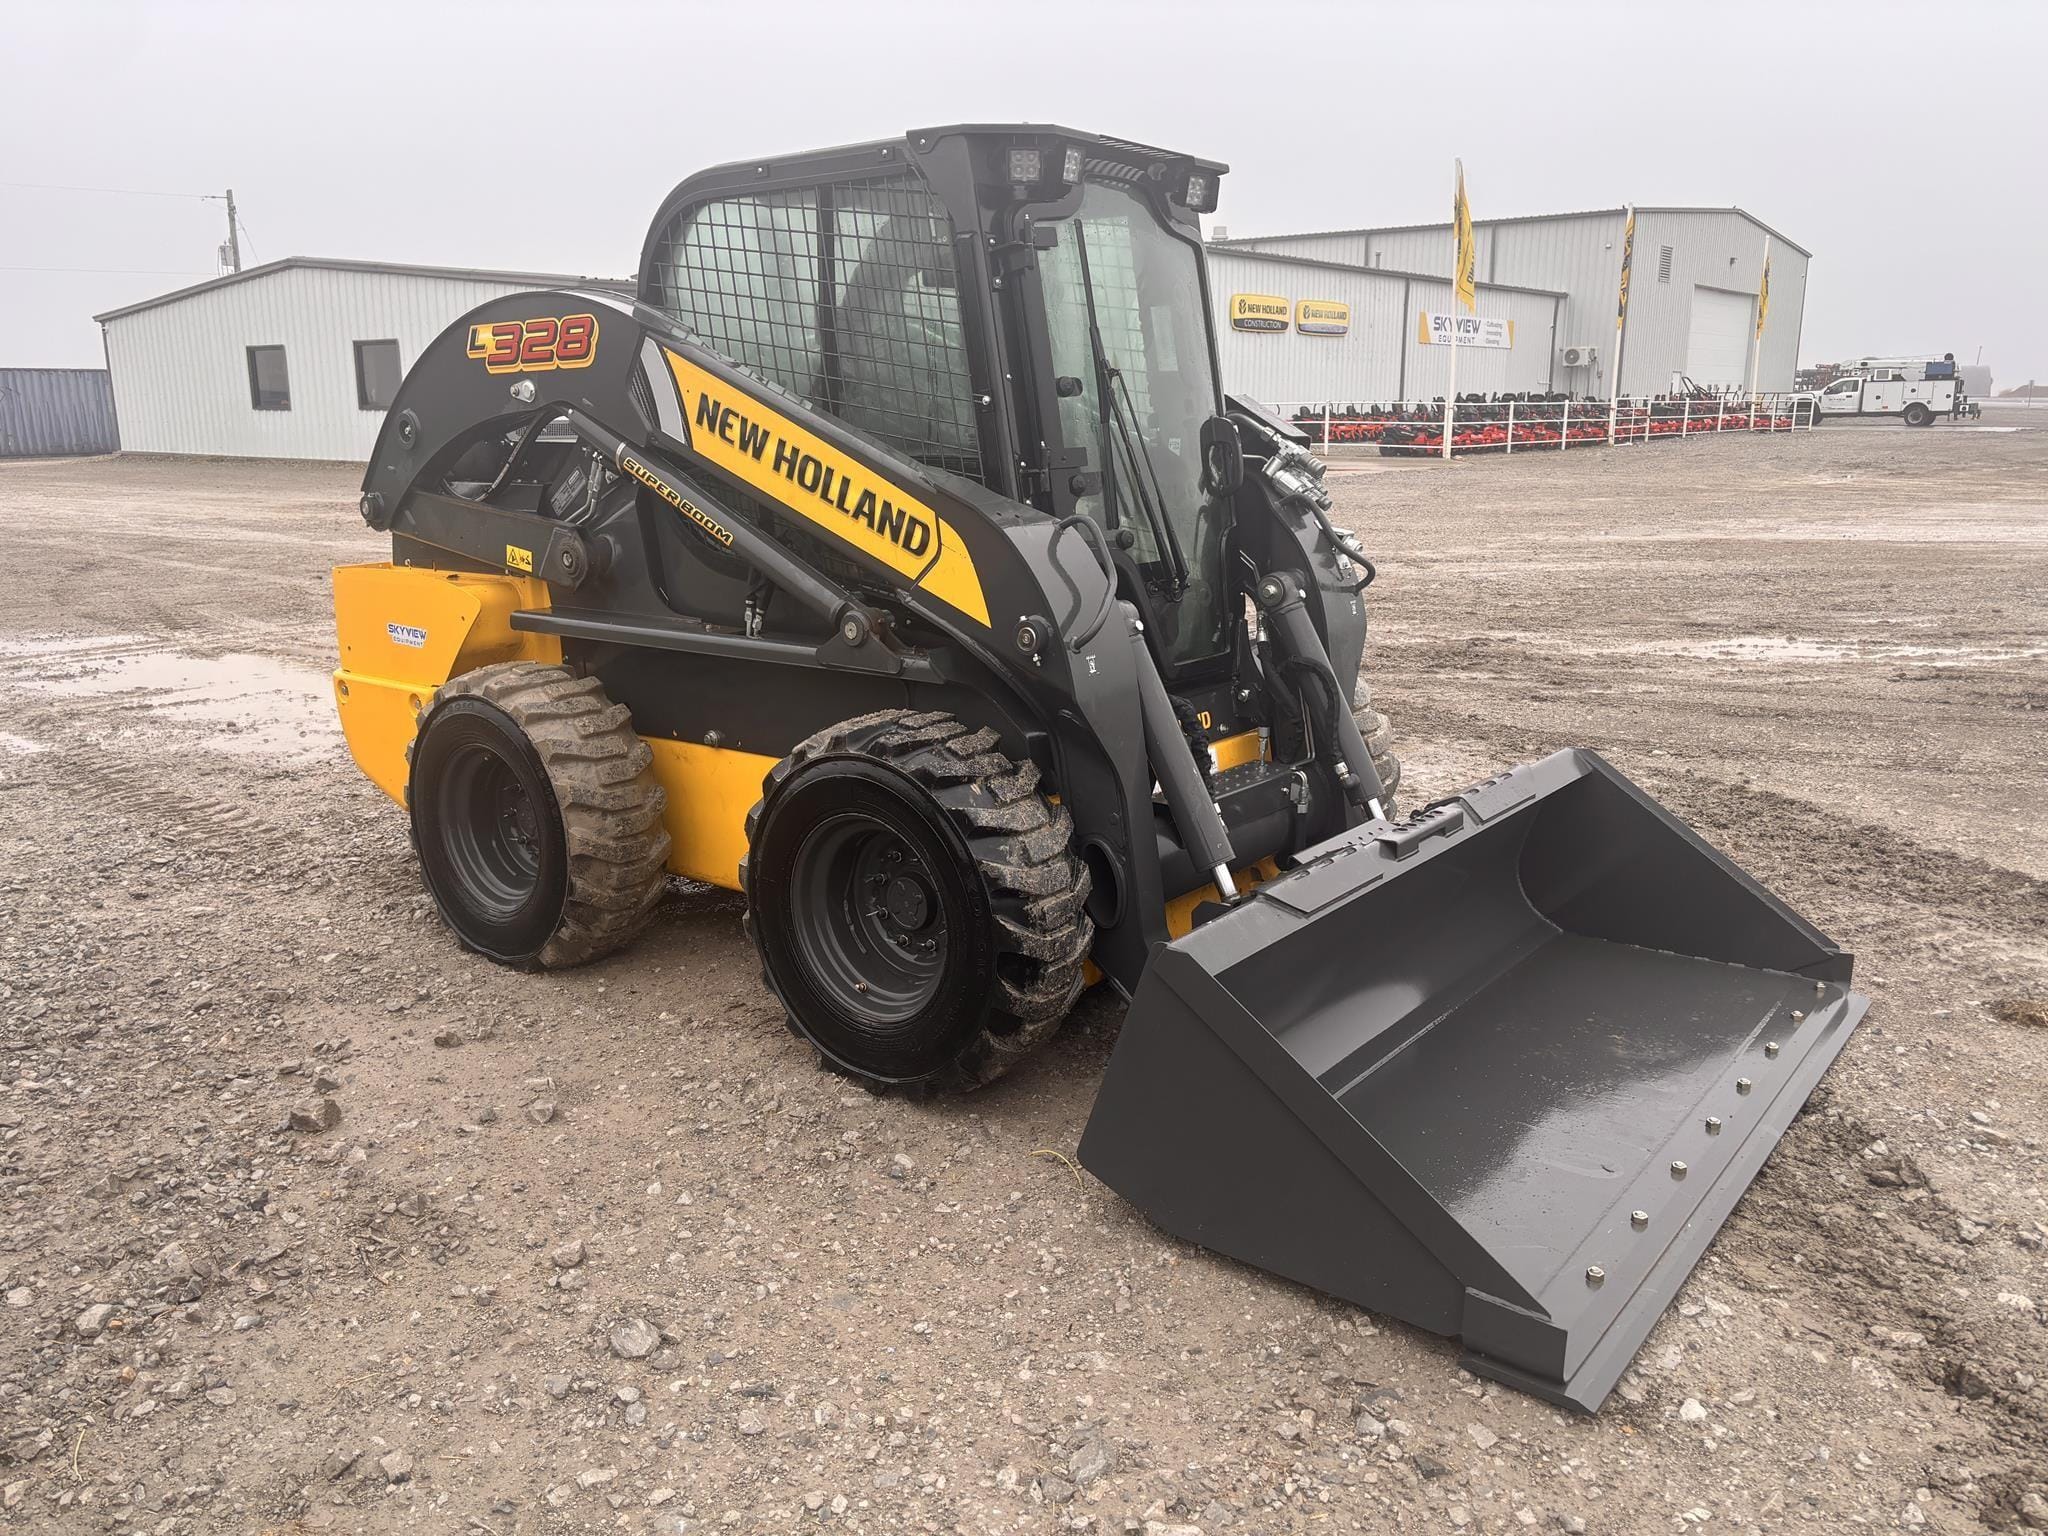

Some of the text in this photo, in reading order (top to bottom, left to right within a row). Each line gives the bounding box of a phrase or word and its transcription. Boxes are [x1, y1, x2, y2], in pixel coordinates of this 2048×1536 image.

[1243, 320, 1282, 329] CONSTRUCTION
[1247, 303, 1288, 316] NEW HOLLAND
[467, 314, 598, 372] L328
[695, 392, 931, 557] NEW HOLLAND
[623, 457, 680, 507] SUPER
[680, 499, 734, 546] BOOM
[388, 623, 427, 640] SKYVIEW
